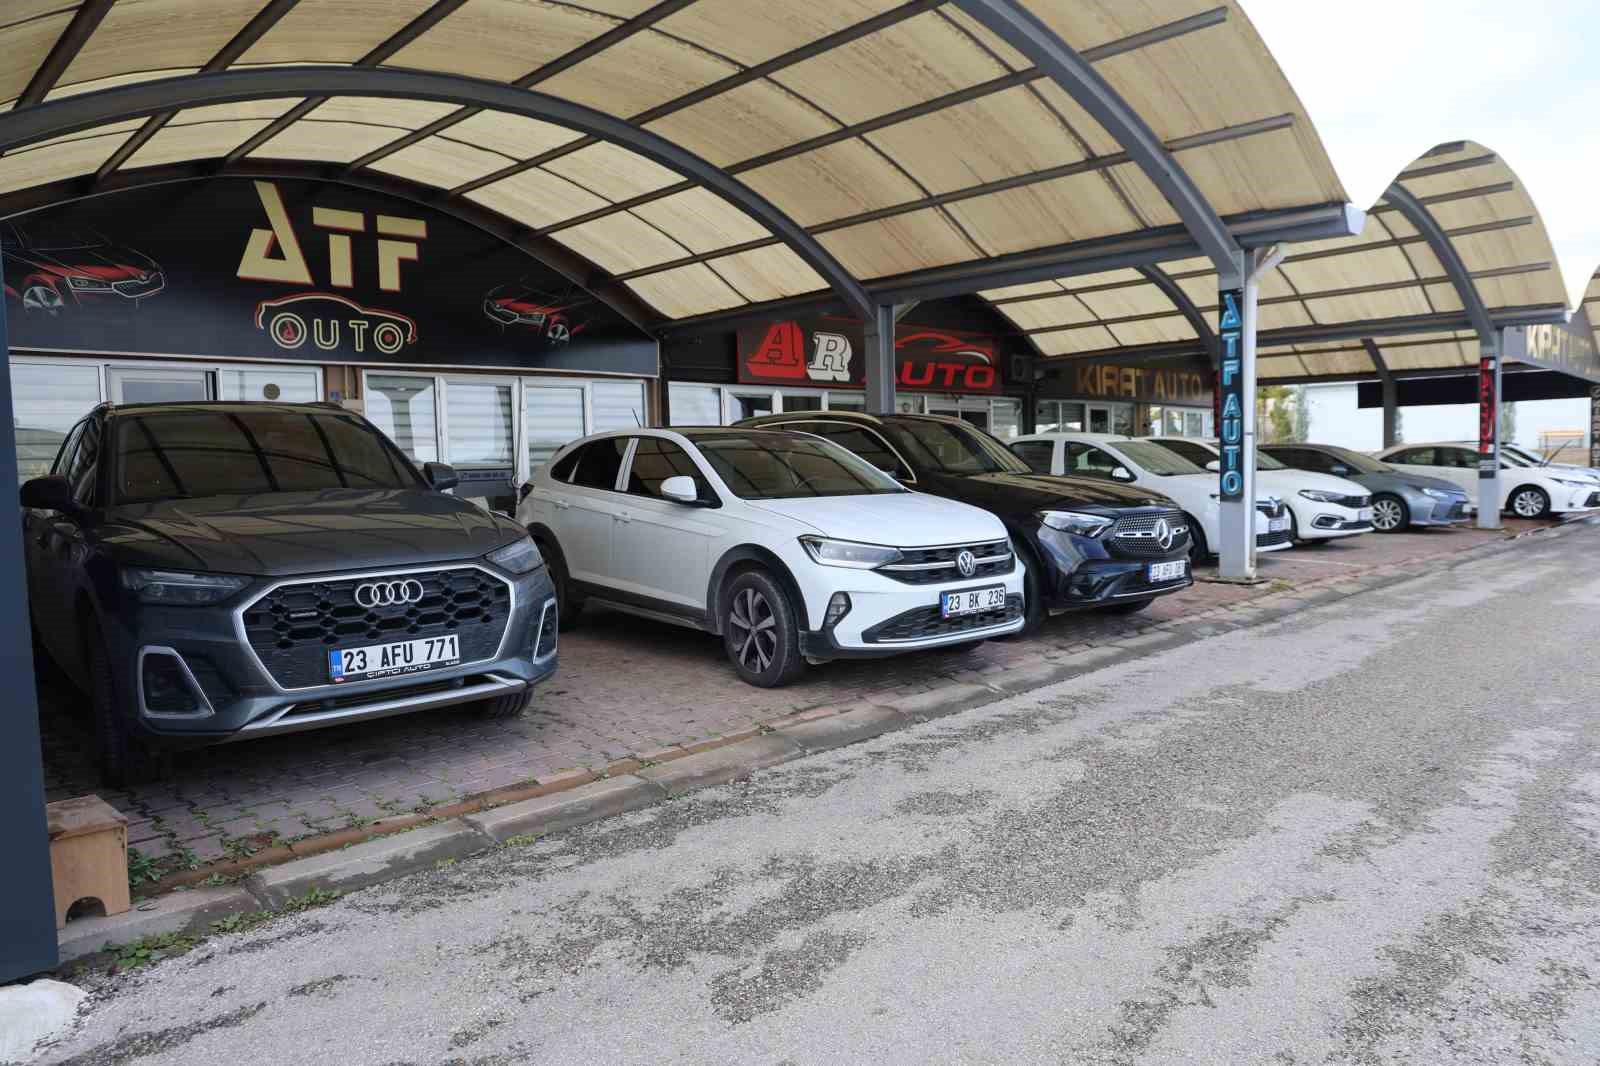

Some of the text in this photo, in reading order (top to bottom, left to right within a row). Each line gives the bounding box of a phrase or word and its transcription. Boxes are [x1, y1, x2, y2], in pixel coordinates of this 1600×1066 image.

[236, 180, 427, 292] ATF
[746, 320, 853, 382] AR
[1153, 368, 1202, 401] AUTO
[1220, 294, 1242, 496] ATF AUTO
[948, 595, 961, 611] 23
[988, 588, 1004, 605] 236
[343, 637, 456, 673] 23 AFU 771
